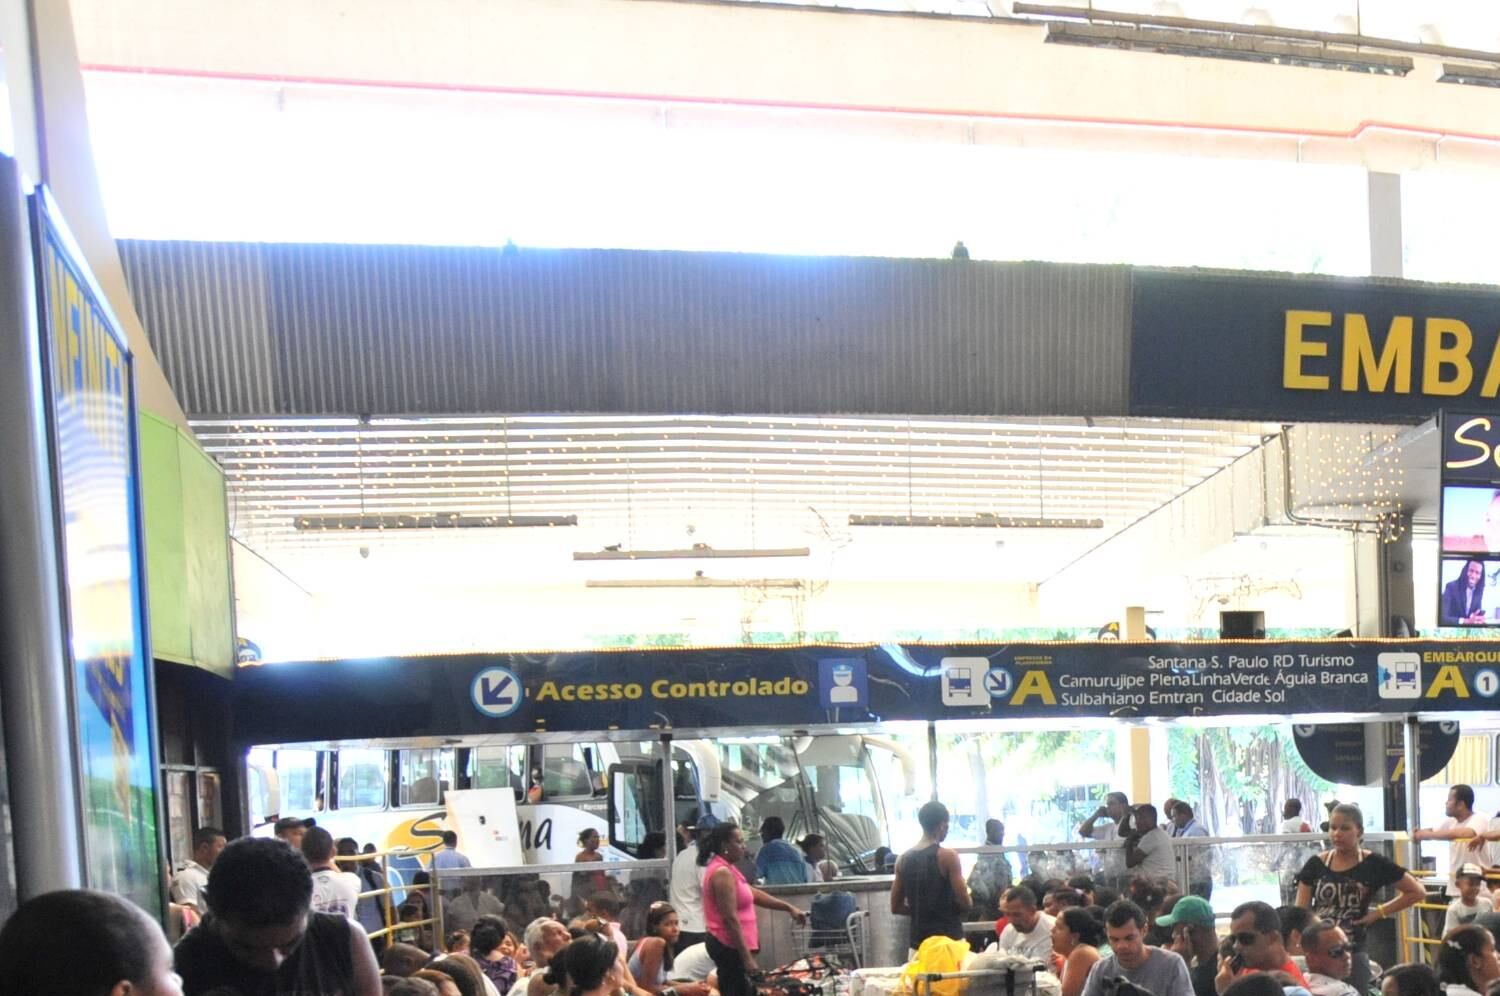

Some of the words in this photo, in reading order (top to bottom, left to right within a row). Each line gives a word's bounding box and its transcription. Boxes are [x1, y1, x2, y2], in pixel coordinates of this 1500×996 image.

[1148, 655, 1206, 669] Santana
[1210, 656, 1224, 669] S.
[1228, 655, 1269, 668] Paulo
[1273, 655, 1294, 668] RD
[1299, 654, 1355, 667] Turismo
[535, 681, 642, 701] Acesso
[651, 677, 809, 699] Controlado
[1009, 670, 1057, 705] A
[1059, 674, 1145, 690] Camurujipe
[1150, 673, 1191, 687] Plena
[1274, 668, 1315, 687] Águia
[1321, 671, 1369, 684] Branca
[1425, 665, 1470, 698] A
[1481, 676, 1491, 692] 1
[1061, 691, 1145, 706] Sulbahiano
[1149, 691, 1204, 705] Emtran
[1211, 690, 1260, 704] Cidade
[1264, 689, 1285, 703] Sol
